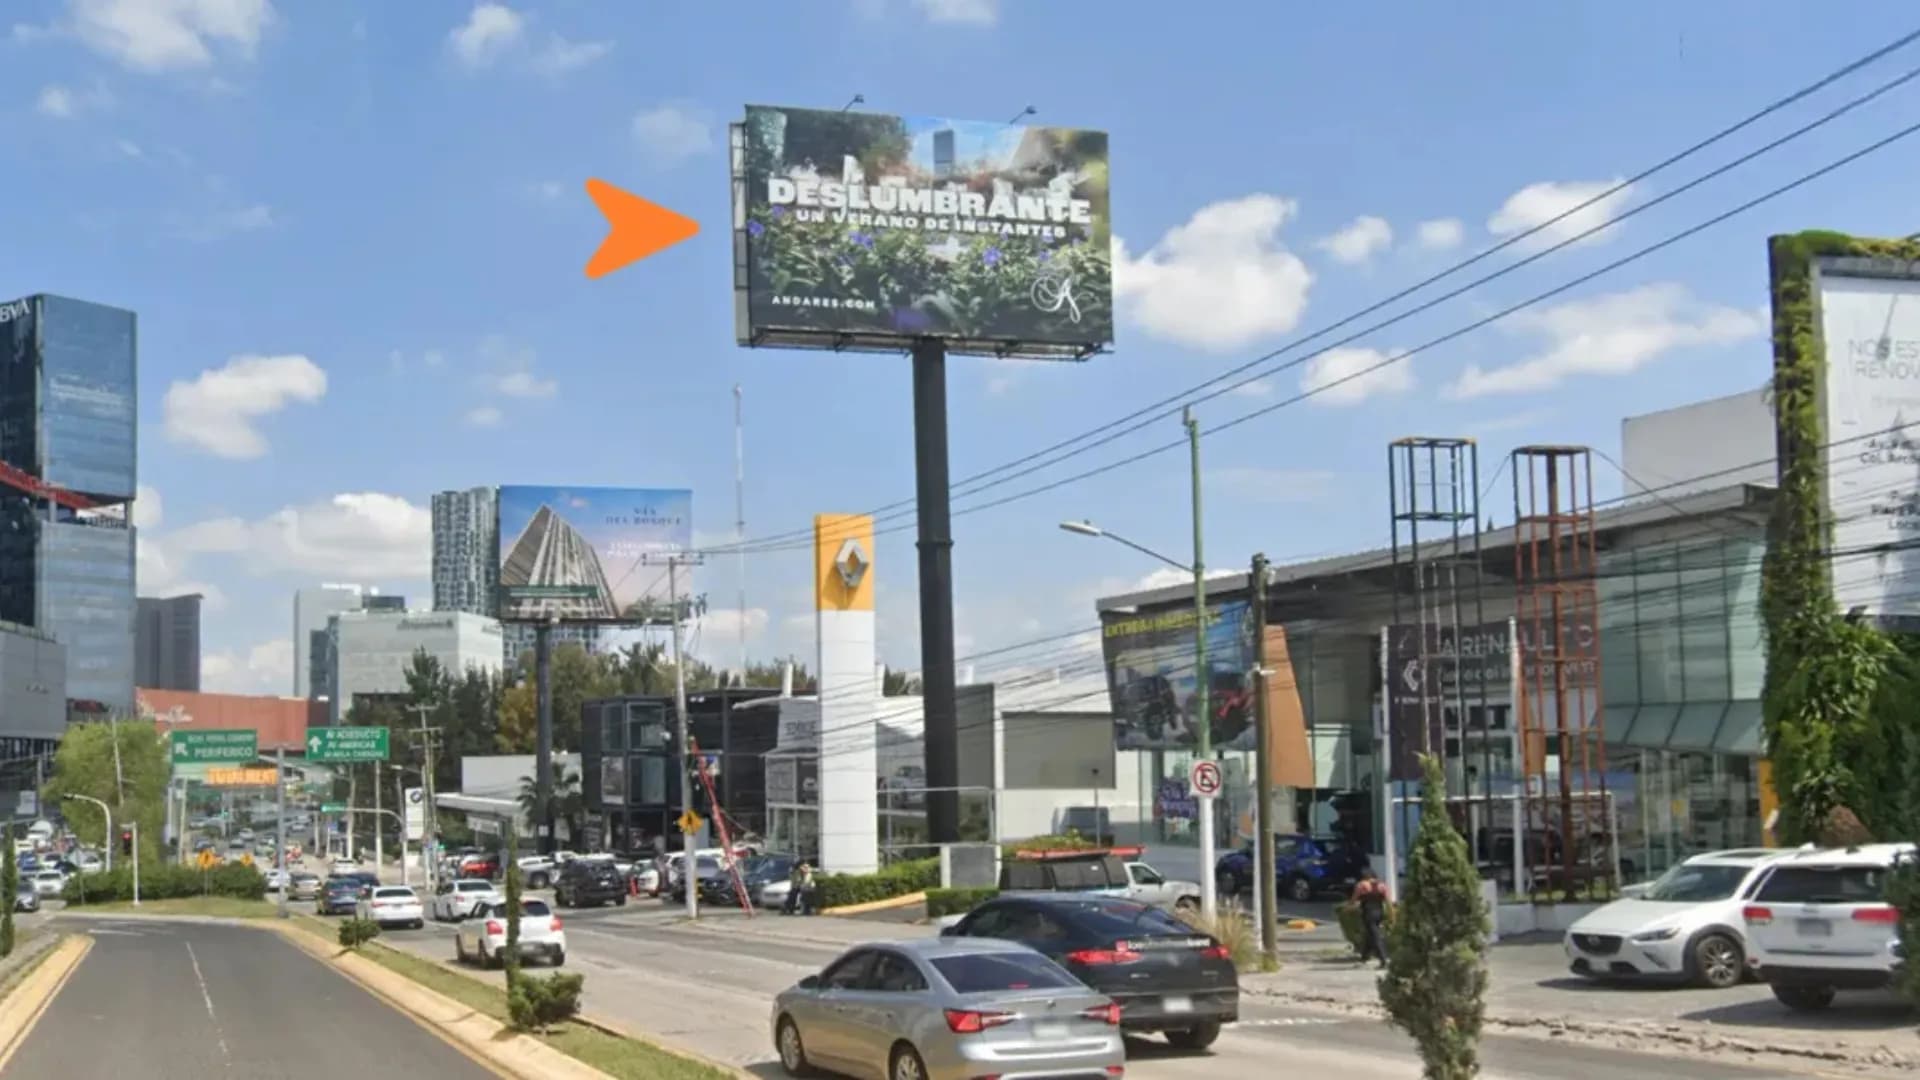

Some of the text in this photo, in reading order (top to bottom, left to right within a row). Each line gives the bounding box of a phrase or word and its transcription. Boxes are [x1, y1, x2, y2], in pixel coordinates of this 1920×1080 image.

[768, 178, 1091, 223] DESLUMBRANTE
[796, 209, 1067, 239] UN VERANO DE INSTANTES
[772, 295, 876, 309] ANDARES.COM
